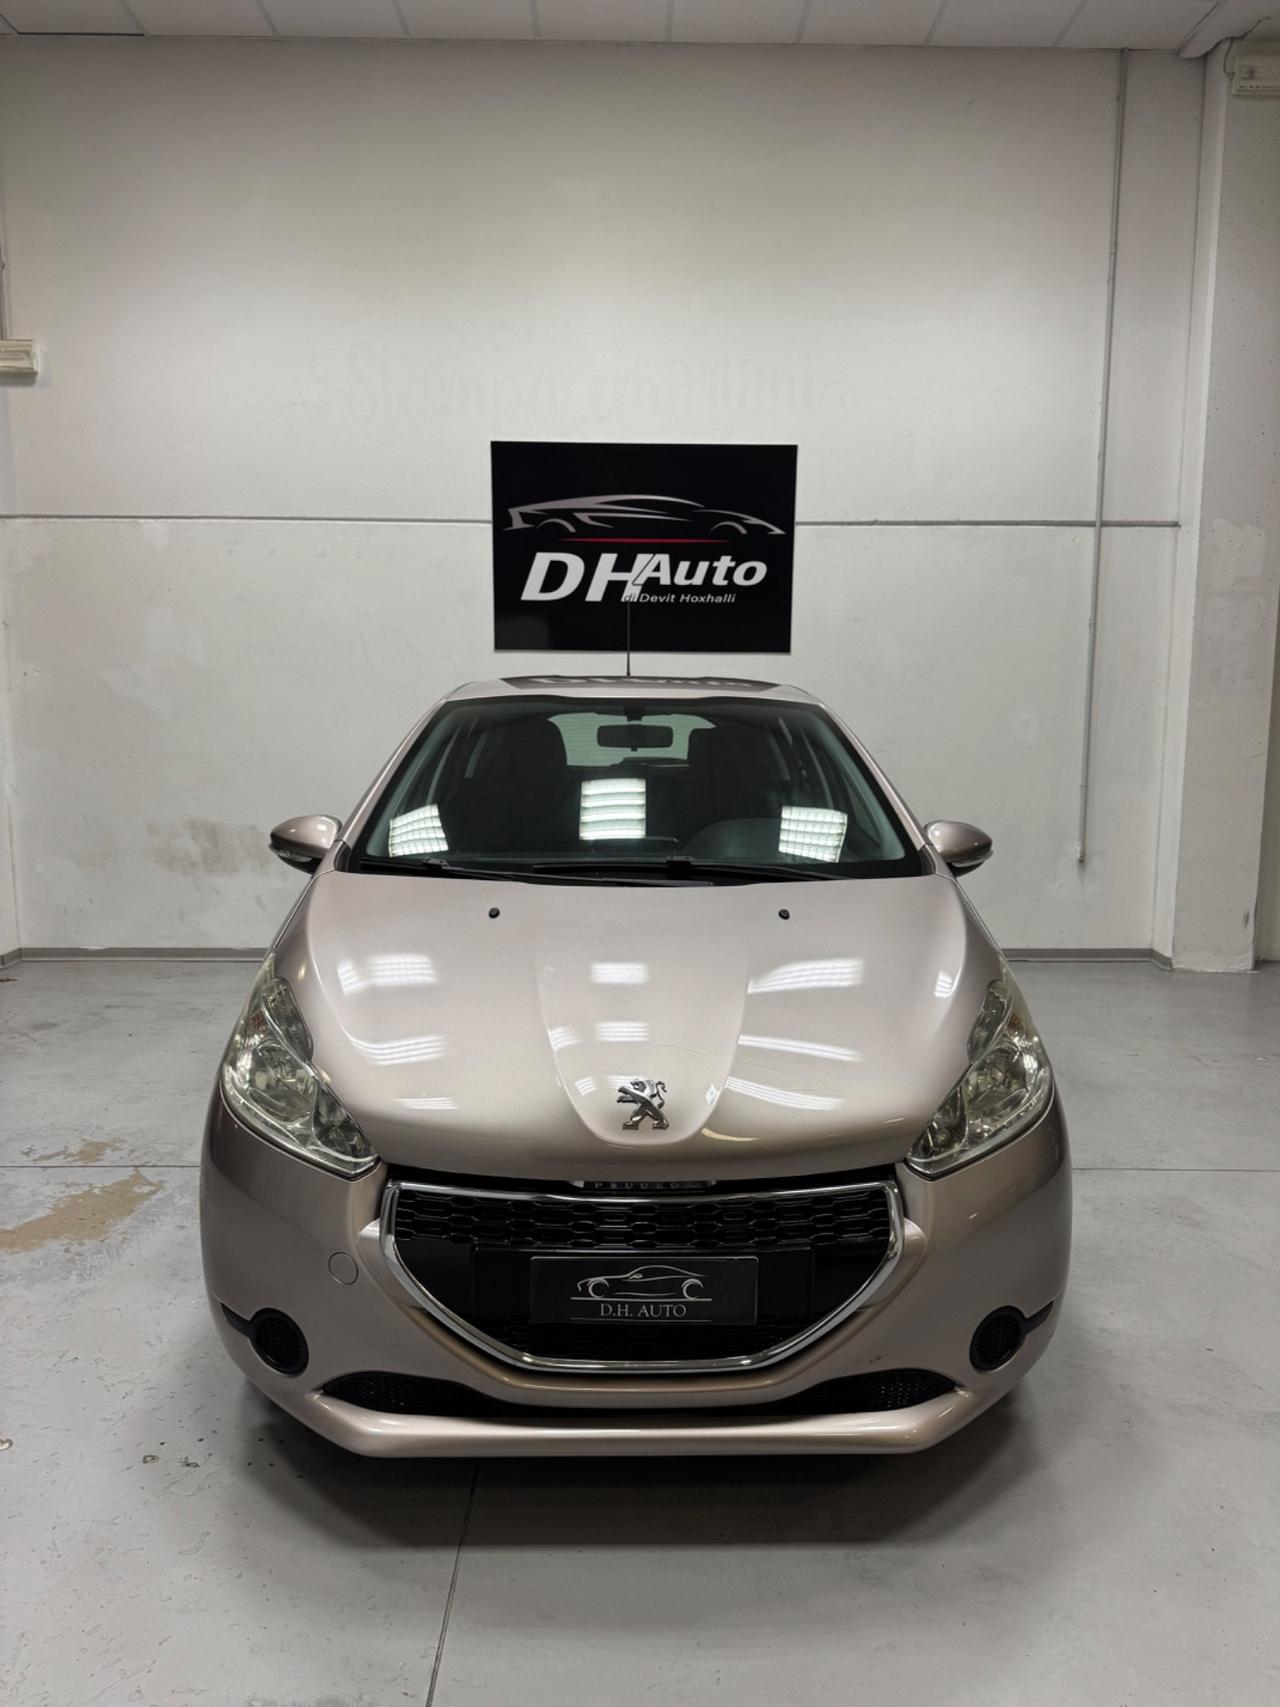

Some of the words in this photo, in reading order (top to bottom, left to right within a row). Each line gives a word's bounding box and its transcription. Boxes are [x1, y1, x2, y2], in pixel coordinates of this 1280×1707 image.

[639, 593, 675, 603] Devit
[680, 593, 737, 603] Hoxhalli
[600, 1304, 634, 1317] D.H.
[637, 1304, 687, 1317] AUTO
